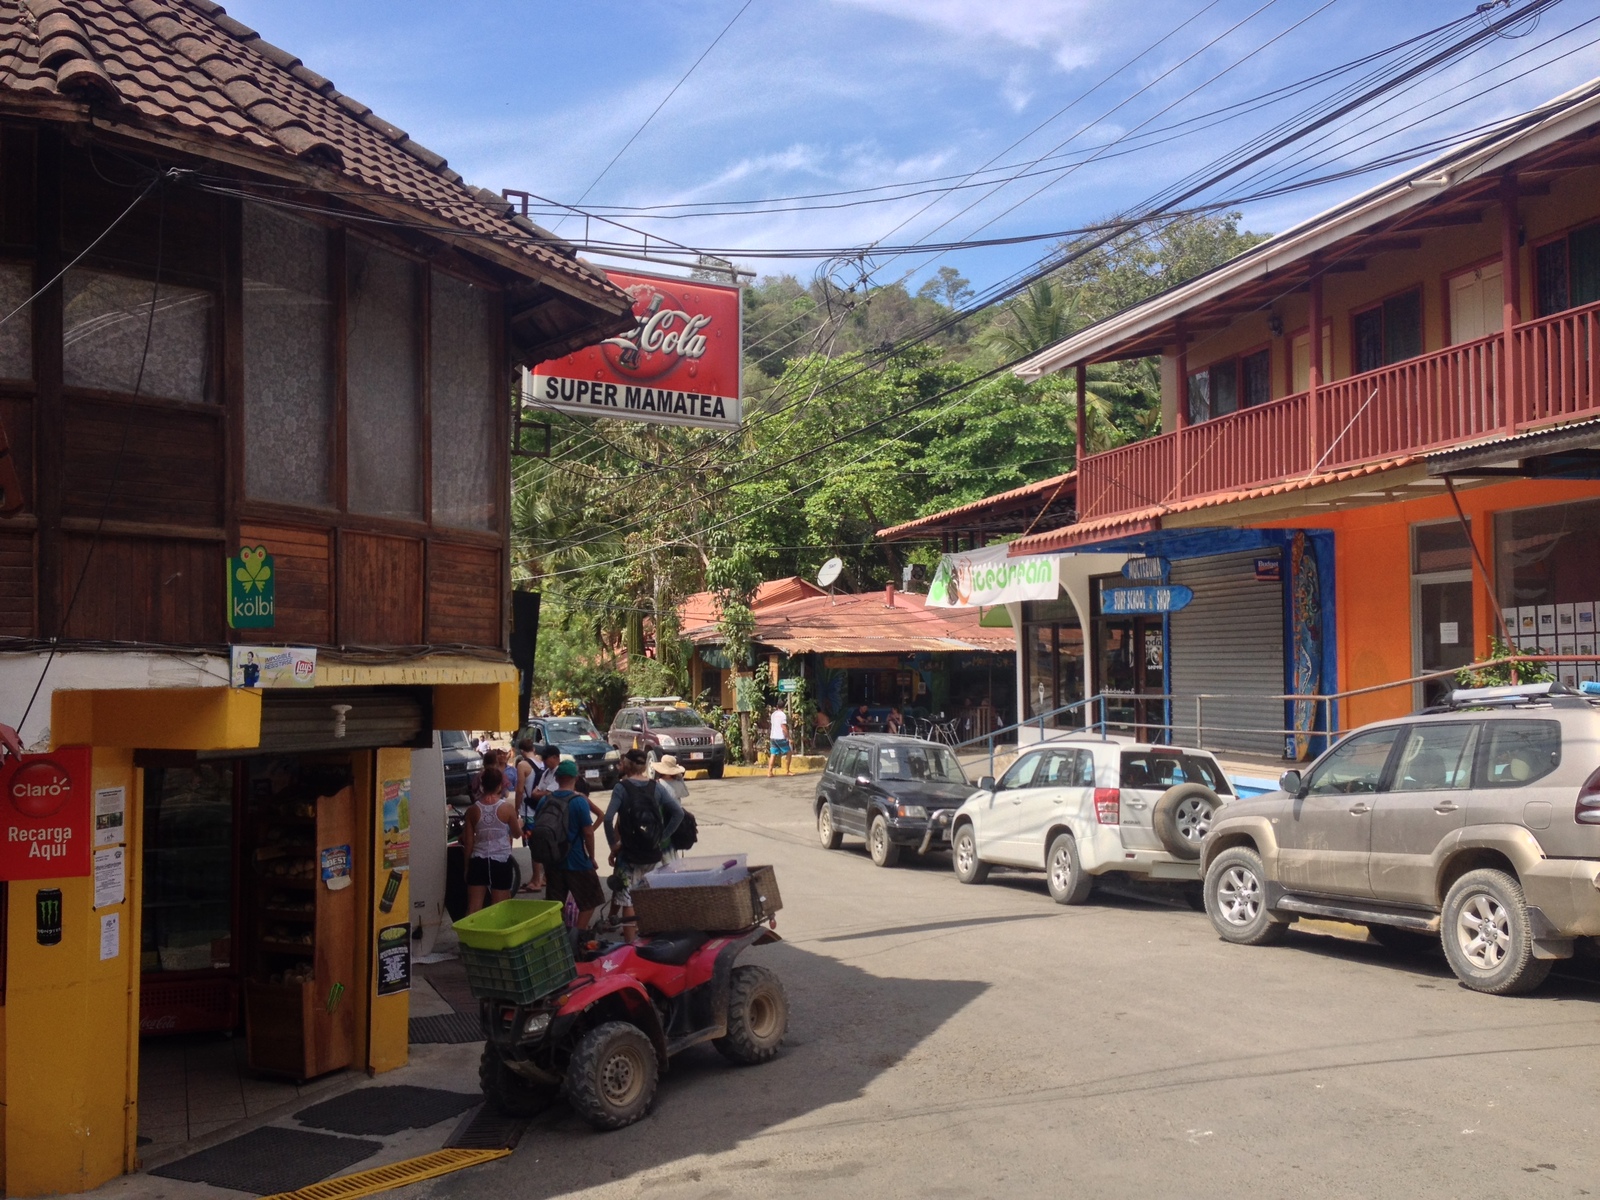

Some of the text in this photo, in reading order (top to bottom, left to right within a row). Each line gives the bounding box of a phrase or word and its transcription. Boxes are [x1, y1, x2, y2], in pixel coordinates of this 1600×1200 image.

[545, 376, 726, 419] SUPER MAMATEA
[1258, 560, 1279, 569] Budget
[234, 596, 273, 616] kölbi
[1114, 590, 1126, 610] SURF
[1127, 589, 1146, 610] SCHOOL
[1156, 589, 1171, 610] SHOP
[12, 781, 62, 798] Claro
[8, 826, 73, 845] Recarga
[28, 839, 68, 861] Aquí
